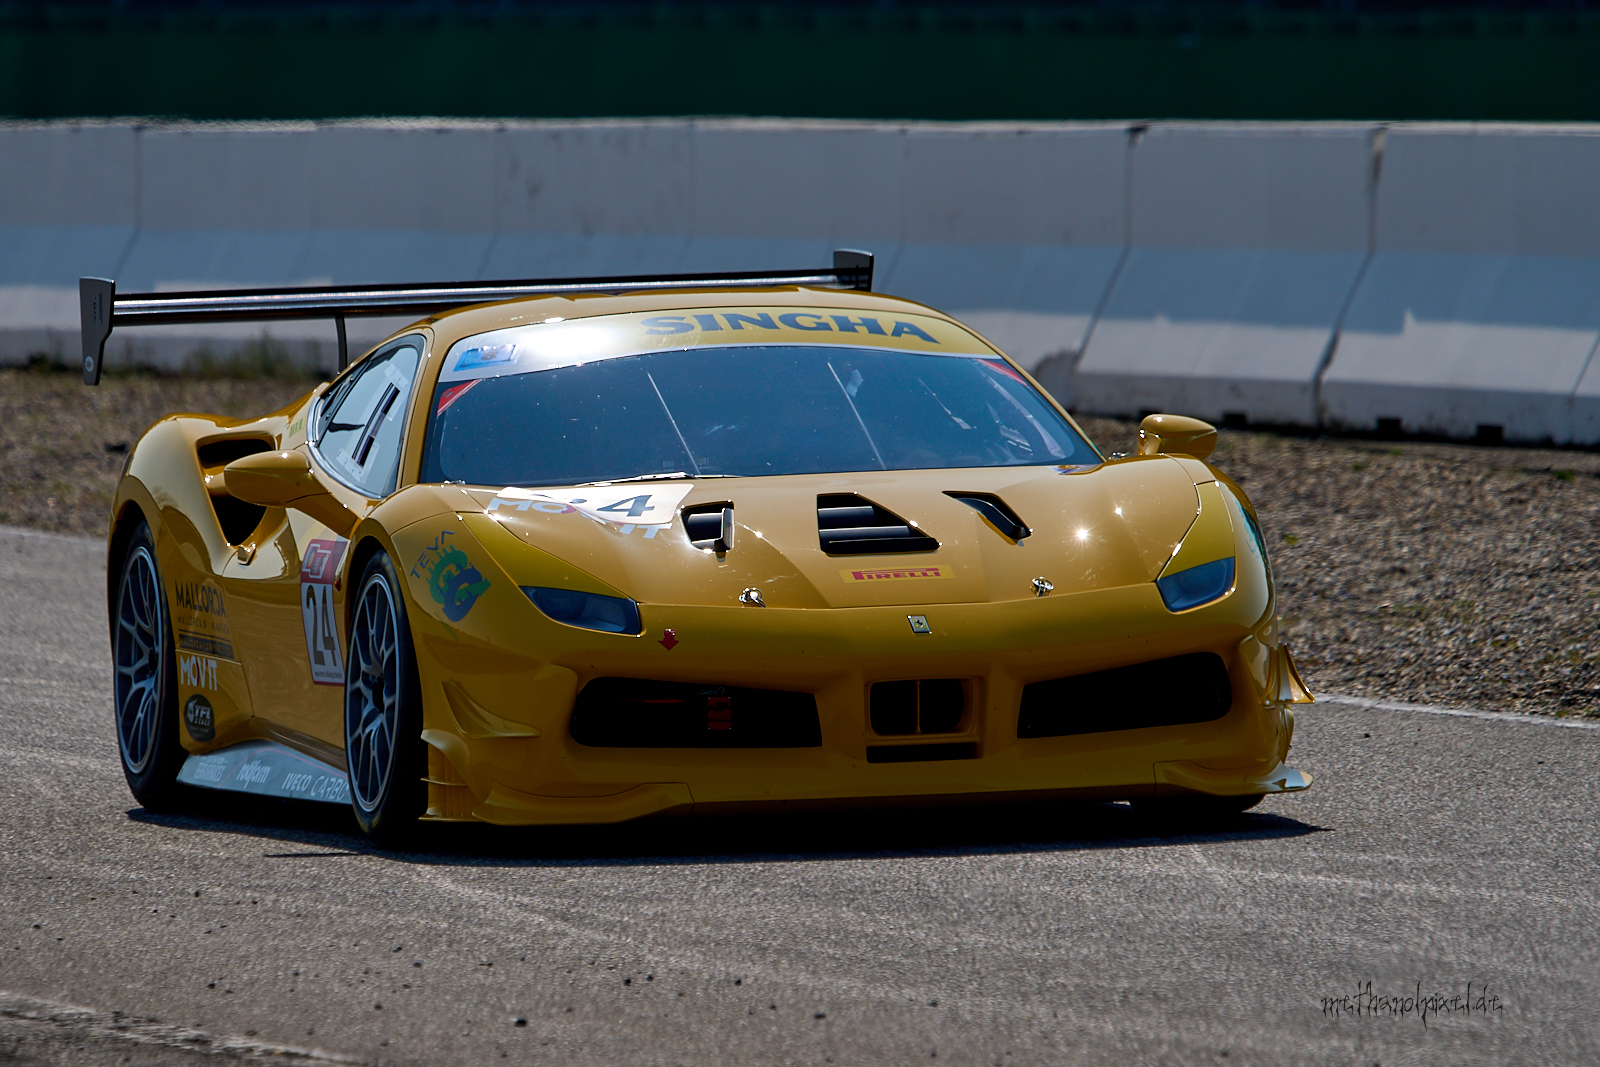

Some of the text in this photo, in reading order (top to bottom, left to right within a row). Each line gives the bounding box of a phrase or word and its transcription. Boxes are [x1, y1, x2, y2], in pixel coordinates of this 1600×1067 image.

[641, 313, 942, 345] SINGHA
[571, 494, 655, 517] 4
[410, 530, 455, 579] TEVA
[852, 568, 941, 580] PIRELLI
[306, 584, 337, 667] 24
[194, 703, 212, 719] TFL
[281, 773, 312, 792] IVECO
